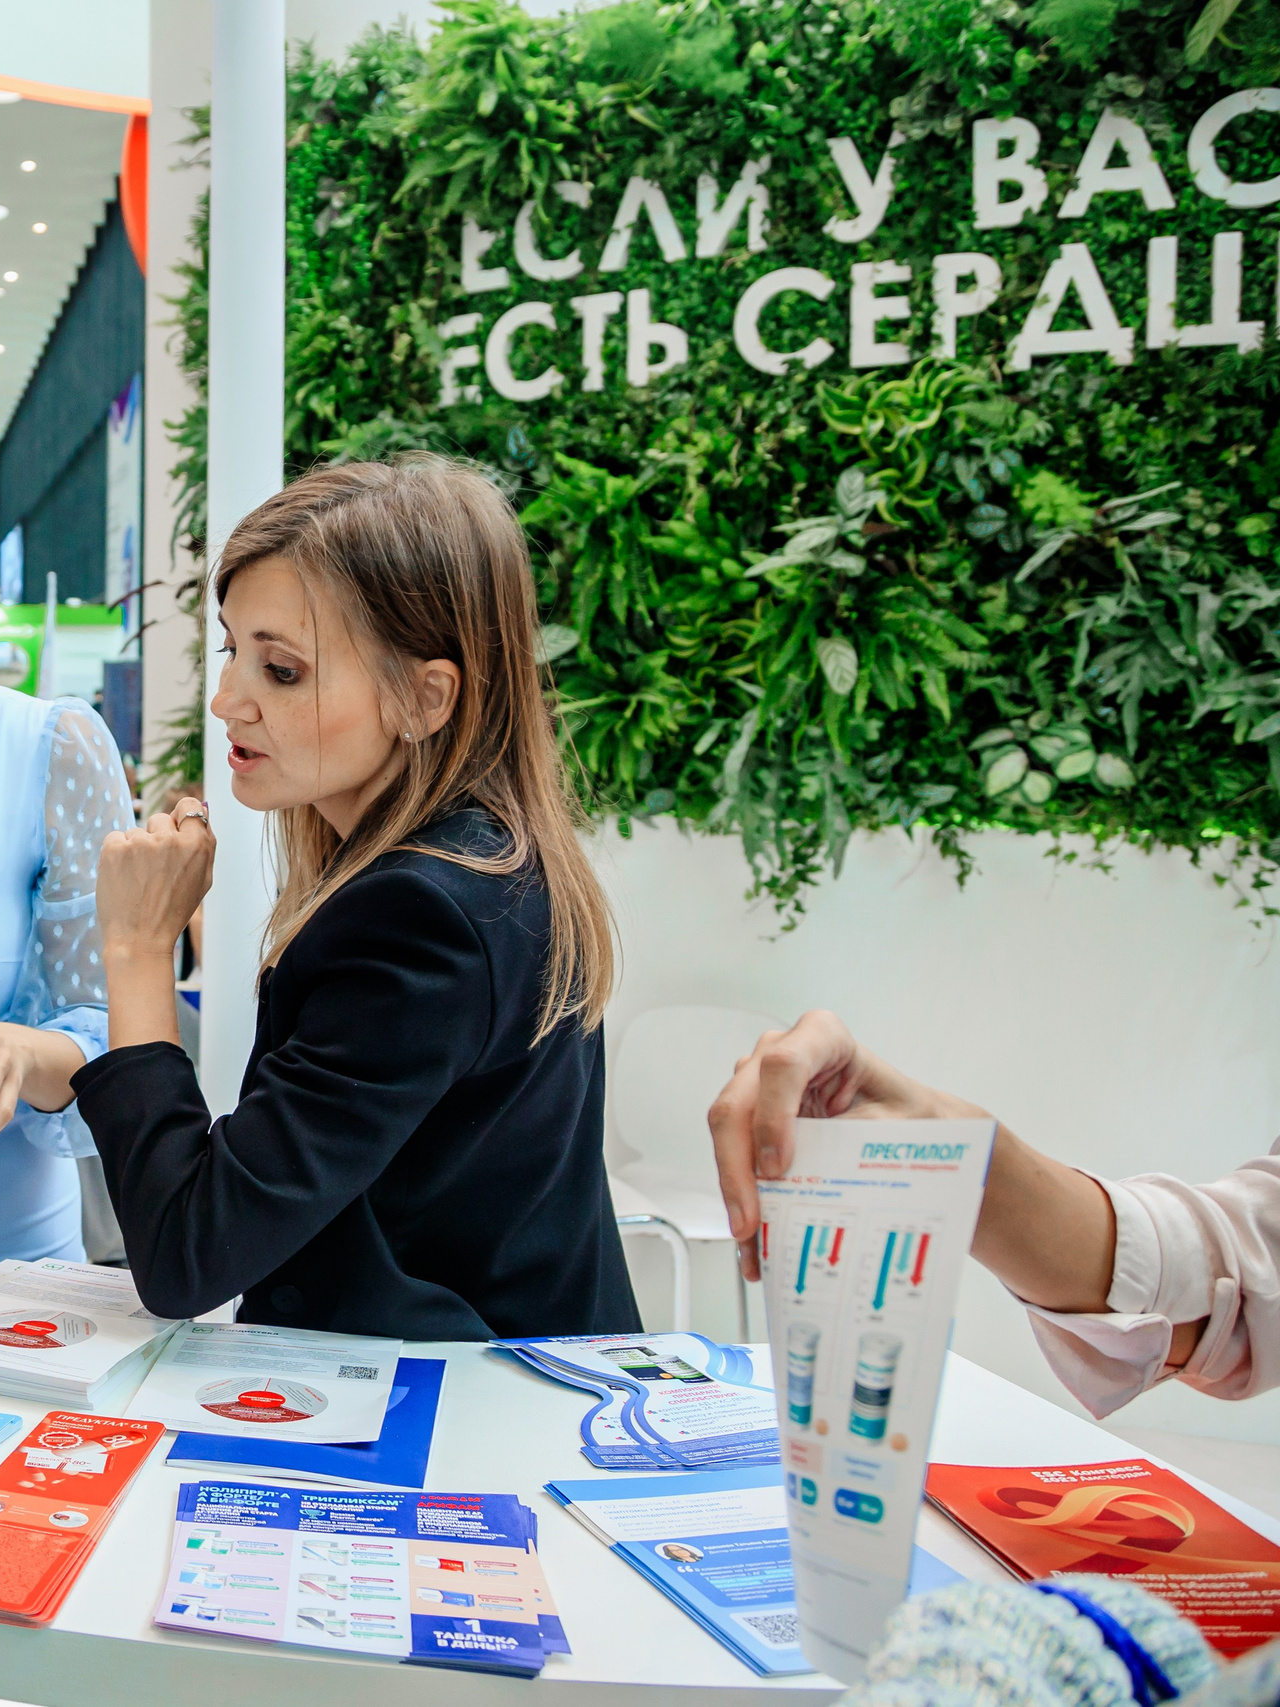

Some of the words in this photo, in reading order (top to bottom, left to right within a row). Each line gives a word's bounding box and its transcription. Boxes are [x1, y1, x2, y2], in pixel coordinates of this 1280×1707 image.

[462, 153, 771, 294] ЕСЛИ
[824, 132, 905, 244] У
[972, 87, 1280, 230] ВАС
[438, 288, 688, 407] ЕСТЬ
[733, 230, 1280, 376] СЕРДЦ
[860, 1143, 966, 1160] ПРЕСТИЛОЛ
[658, 1384, 721, 1396] КОМПОНЕНТЫ
[672, 1389, 721, 1399] ПРЕПАРАТА
[102, 1435, 134, 1449] 80
[1030, 1470, 1066, 1478] ESC
[1069, 1465, 1143, 1476] Конгресс
[1080, 1471, 1152, 1482] Амстердам
[210, 1497, 280, 1508] БИ-ФОРТЕ
[211, 1492, 263, 1501] ФОРТЕ/
[464, 1619, 482, 1633] 1
[433, 1630, 519, 1646] ТАБЛЕТКА
[437, 1638, 448, 1647] В
